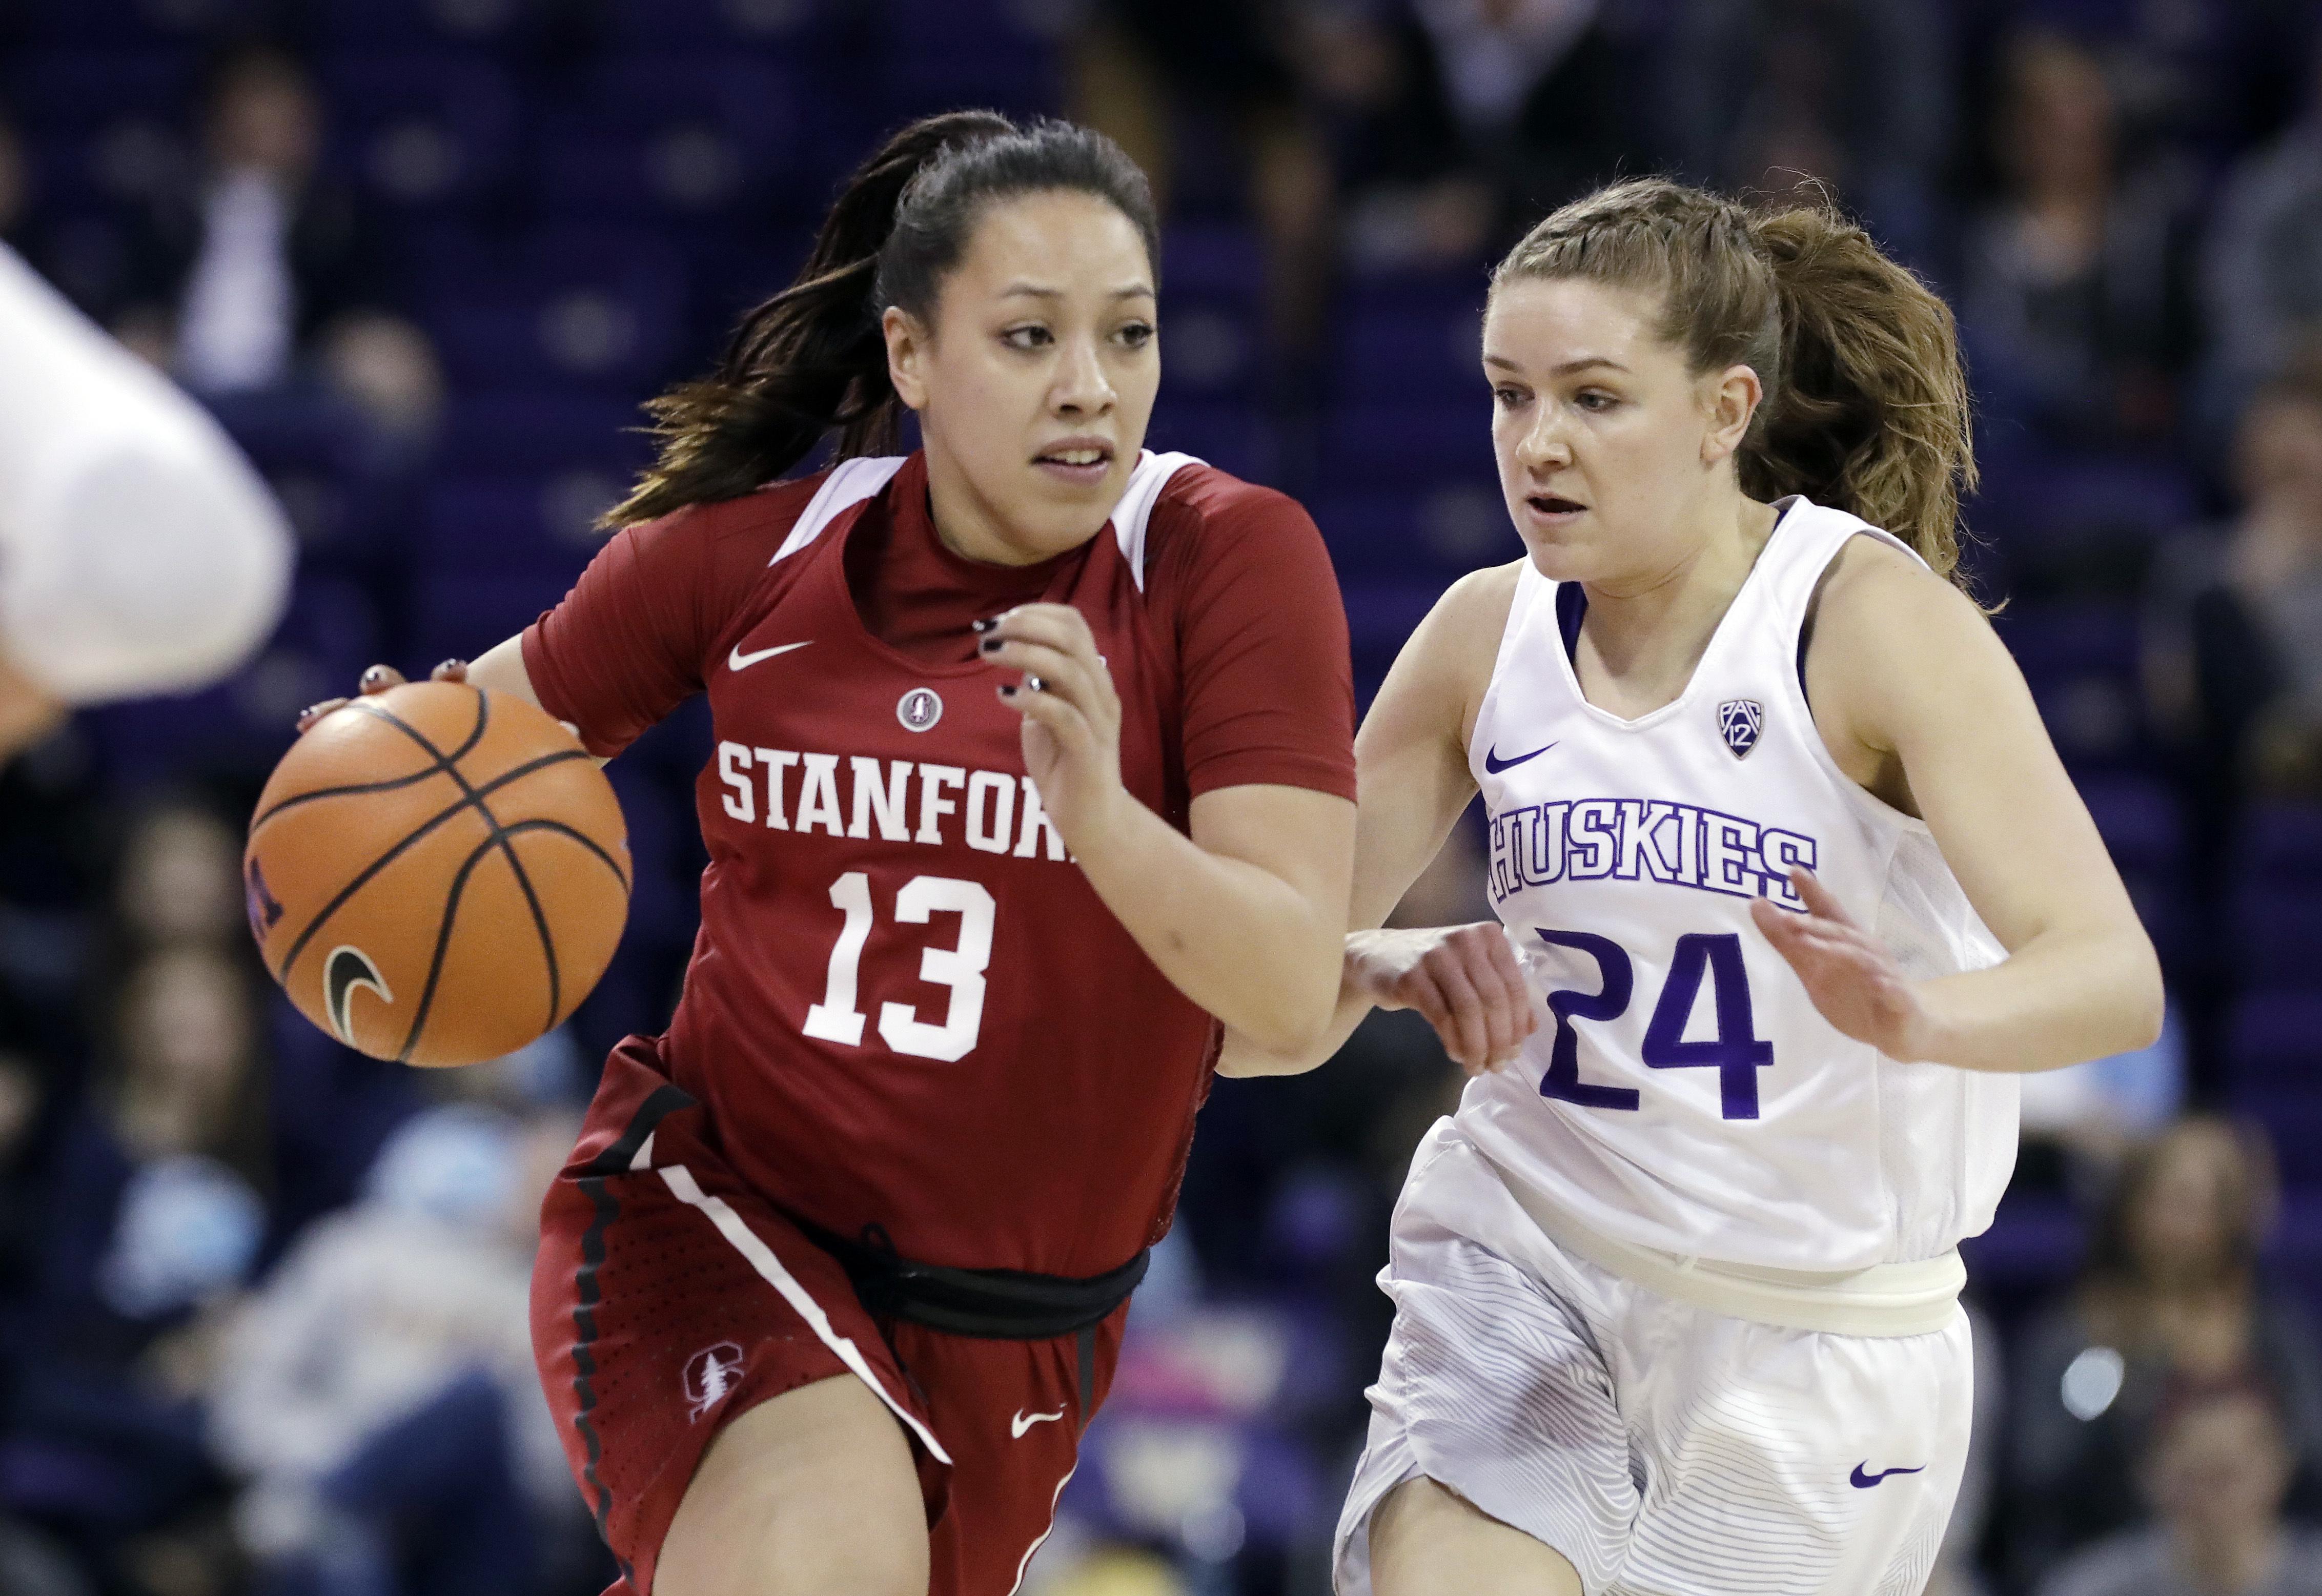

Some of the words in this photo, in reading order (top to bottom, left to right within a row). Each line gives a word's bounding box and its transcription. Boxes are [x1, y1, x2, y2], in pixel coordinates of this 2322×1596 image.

[1720, 700, 1761, 734] PAC
[1729, 723, 1753, 746] 12
[718, 740, 1077, 863] STANFOR
[1489, 798, 1817, 914] HUSKIES
[802, 871, 996, 1062] 13
[1535, 927, 1774, 1120] 24
